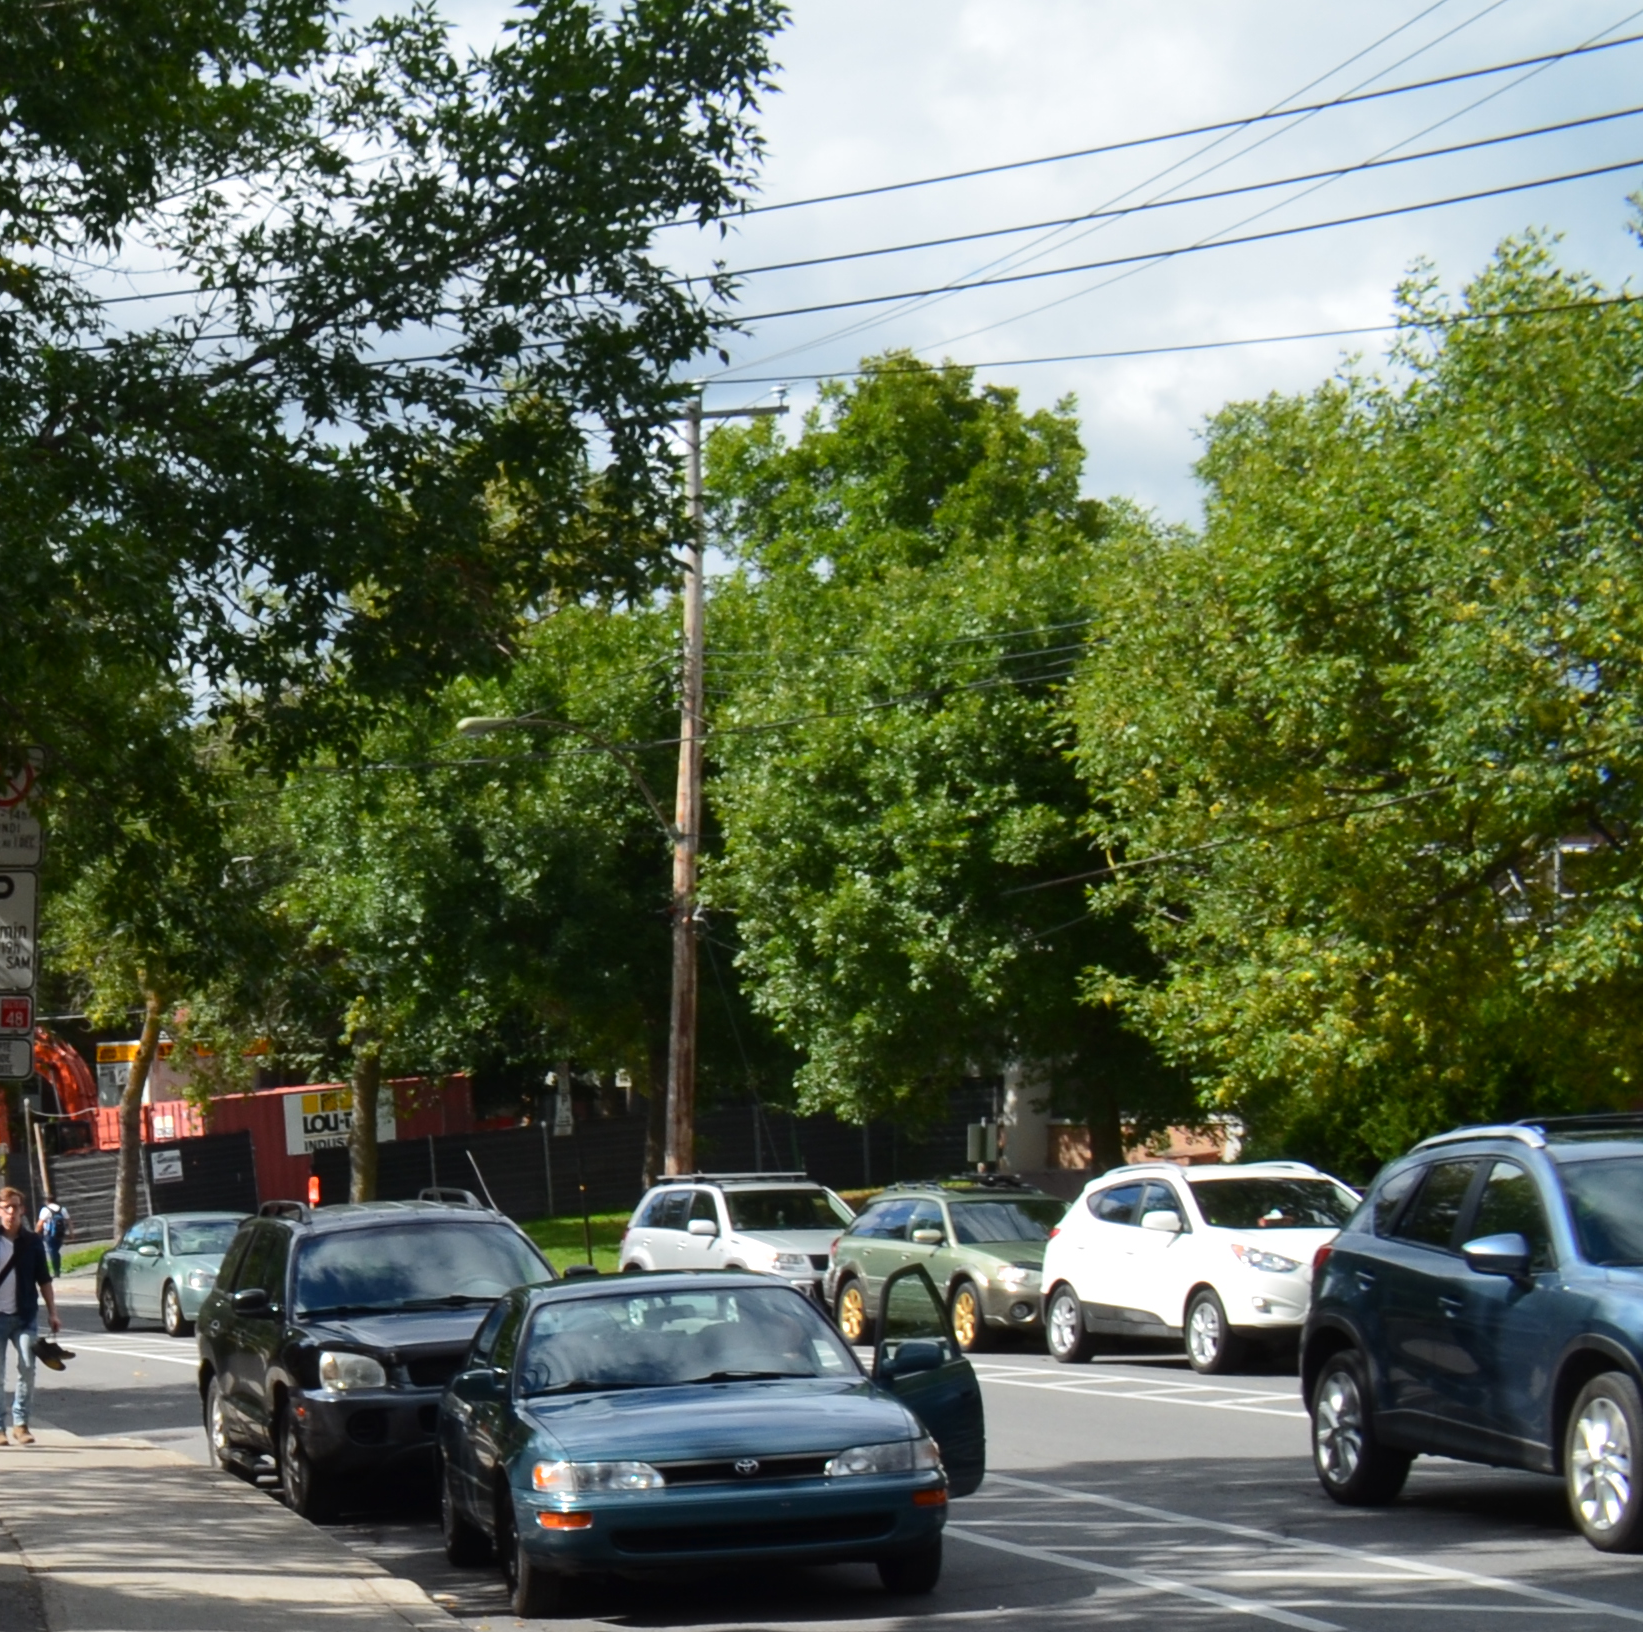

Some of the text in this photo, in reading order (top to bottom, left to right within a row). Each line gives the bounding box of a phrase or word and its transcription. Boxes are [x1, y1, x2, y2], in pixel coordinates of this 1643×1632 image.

[0, 922, 28, 939] min
[6, 956, 31, 969] SAM
[5, 1011, 24, 1027] 48
[302, 1111, 353, 1134] LOU-T
[304, 1136, 346, 1152] INDUS
